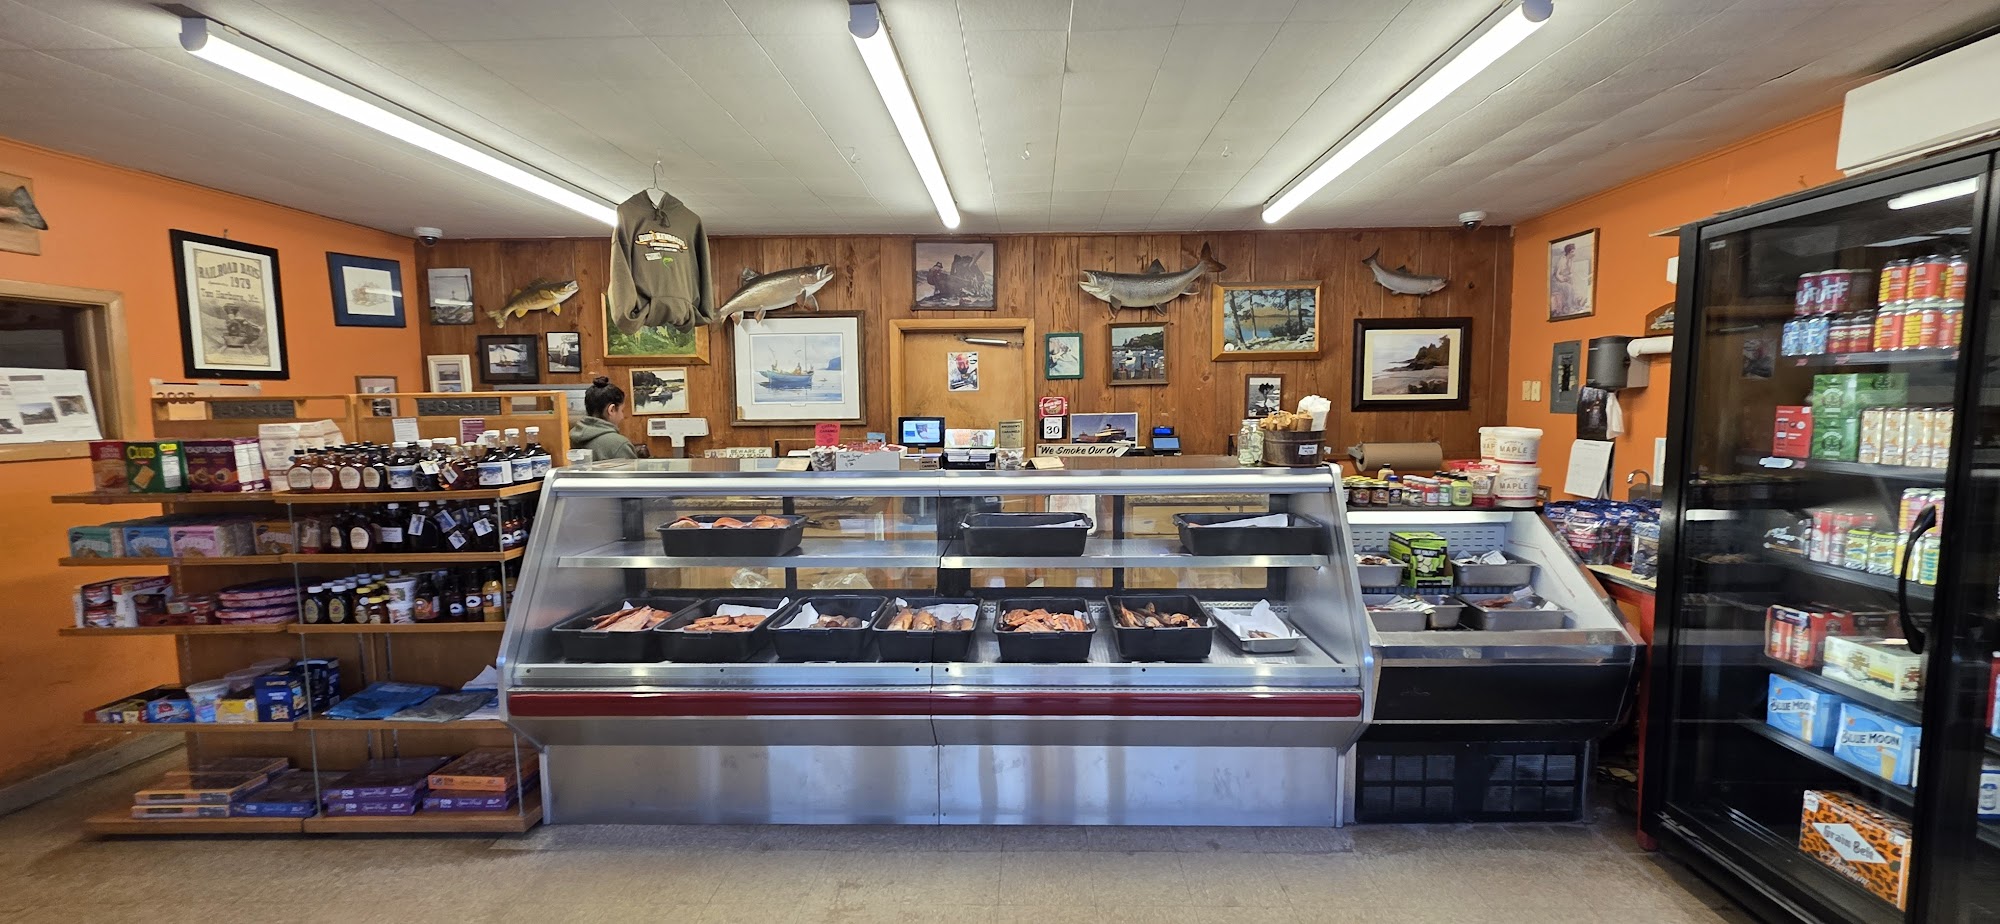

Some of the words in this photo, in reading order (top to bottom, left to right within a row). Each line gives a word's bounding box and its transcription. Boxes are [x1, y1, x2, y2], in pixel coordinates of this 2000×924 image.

[198, 262, 238, 279] RAILROAD
[240, 262, 260, 280] DAYS
[230, 276, 252, 290] 1979
[1046, 425, 1060, 435] 30
[126, 445, 156, 460] CLUB
[1055, 446, 1086, 455] Smoke
[1087, 445, 1105, 455] Our
[1499, 445, 1528, 454] MAPLE
[1499, 482, 1529, 490] MAPLE
[1770, 698, 1792, 712] BLUE
[1841, 730, 1866, 744] BLUE
[1867, 733, 1900, 746] MOON
[1823, 825, 1852, 848] Grain
[1853, 841, 1874, 860] Belt
